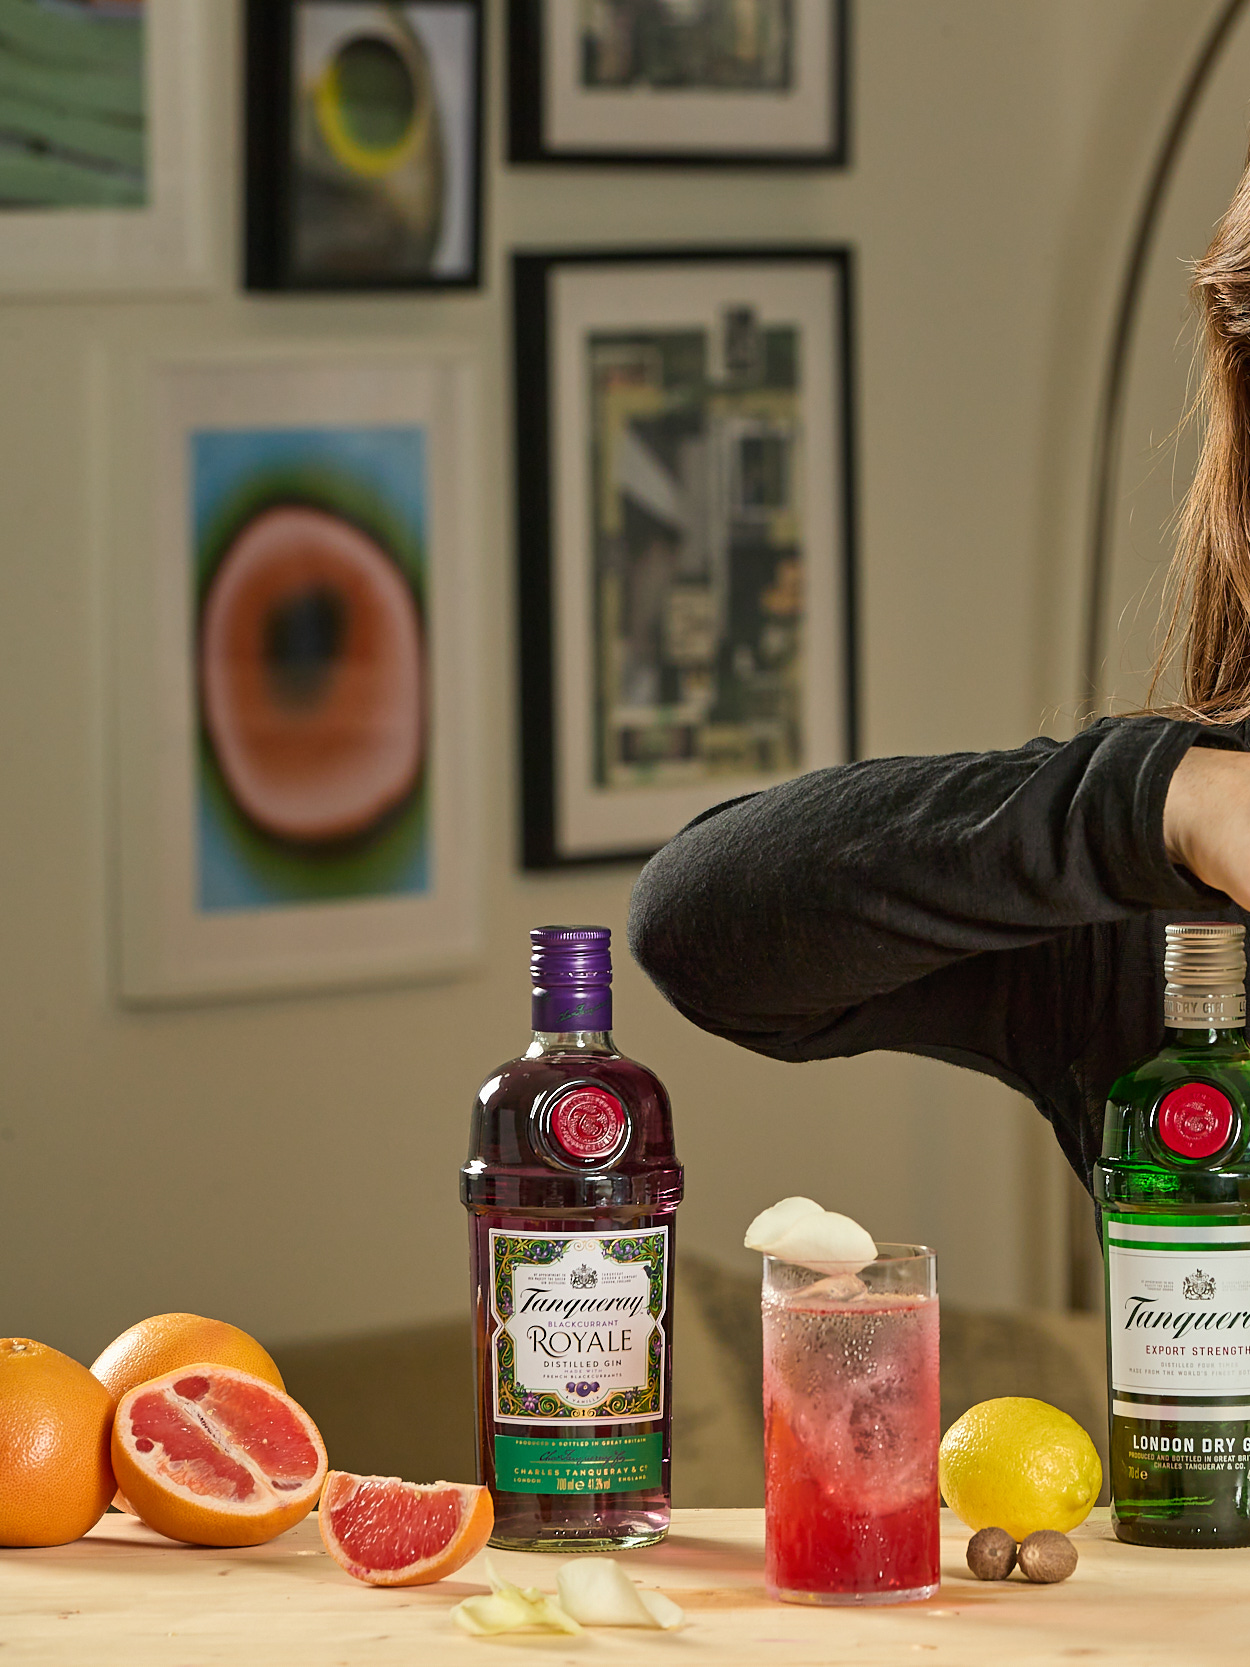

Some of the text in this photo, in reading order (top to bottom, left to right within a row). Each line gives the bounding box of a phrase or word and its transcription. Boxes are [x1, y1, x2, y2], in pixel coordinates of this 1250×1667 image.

[520, 1288, 644, 1319] Tanqueray
[526, 1326, 632, 1358] ROYALE
[1146, 1344, 1186, 1356] EXPORT
[1133, 1434, 1194, 1452] LONDON
[1202, 1438, 1235, 1453] DRY
[1129, 1451, 1154, 1460] PRODUCED
[1214, 1454, 1236, 1462] GREAT
[514, 1468, 559, 1476] CHARLES
[1154, 1462, 1183, 1470] CHARLES
